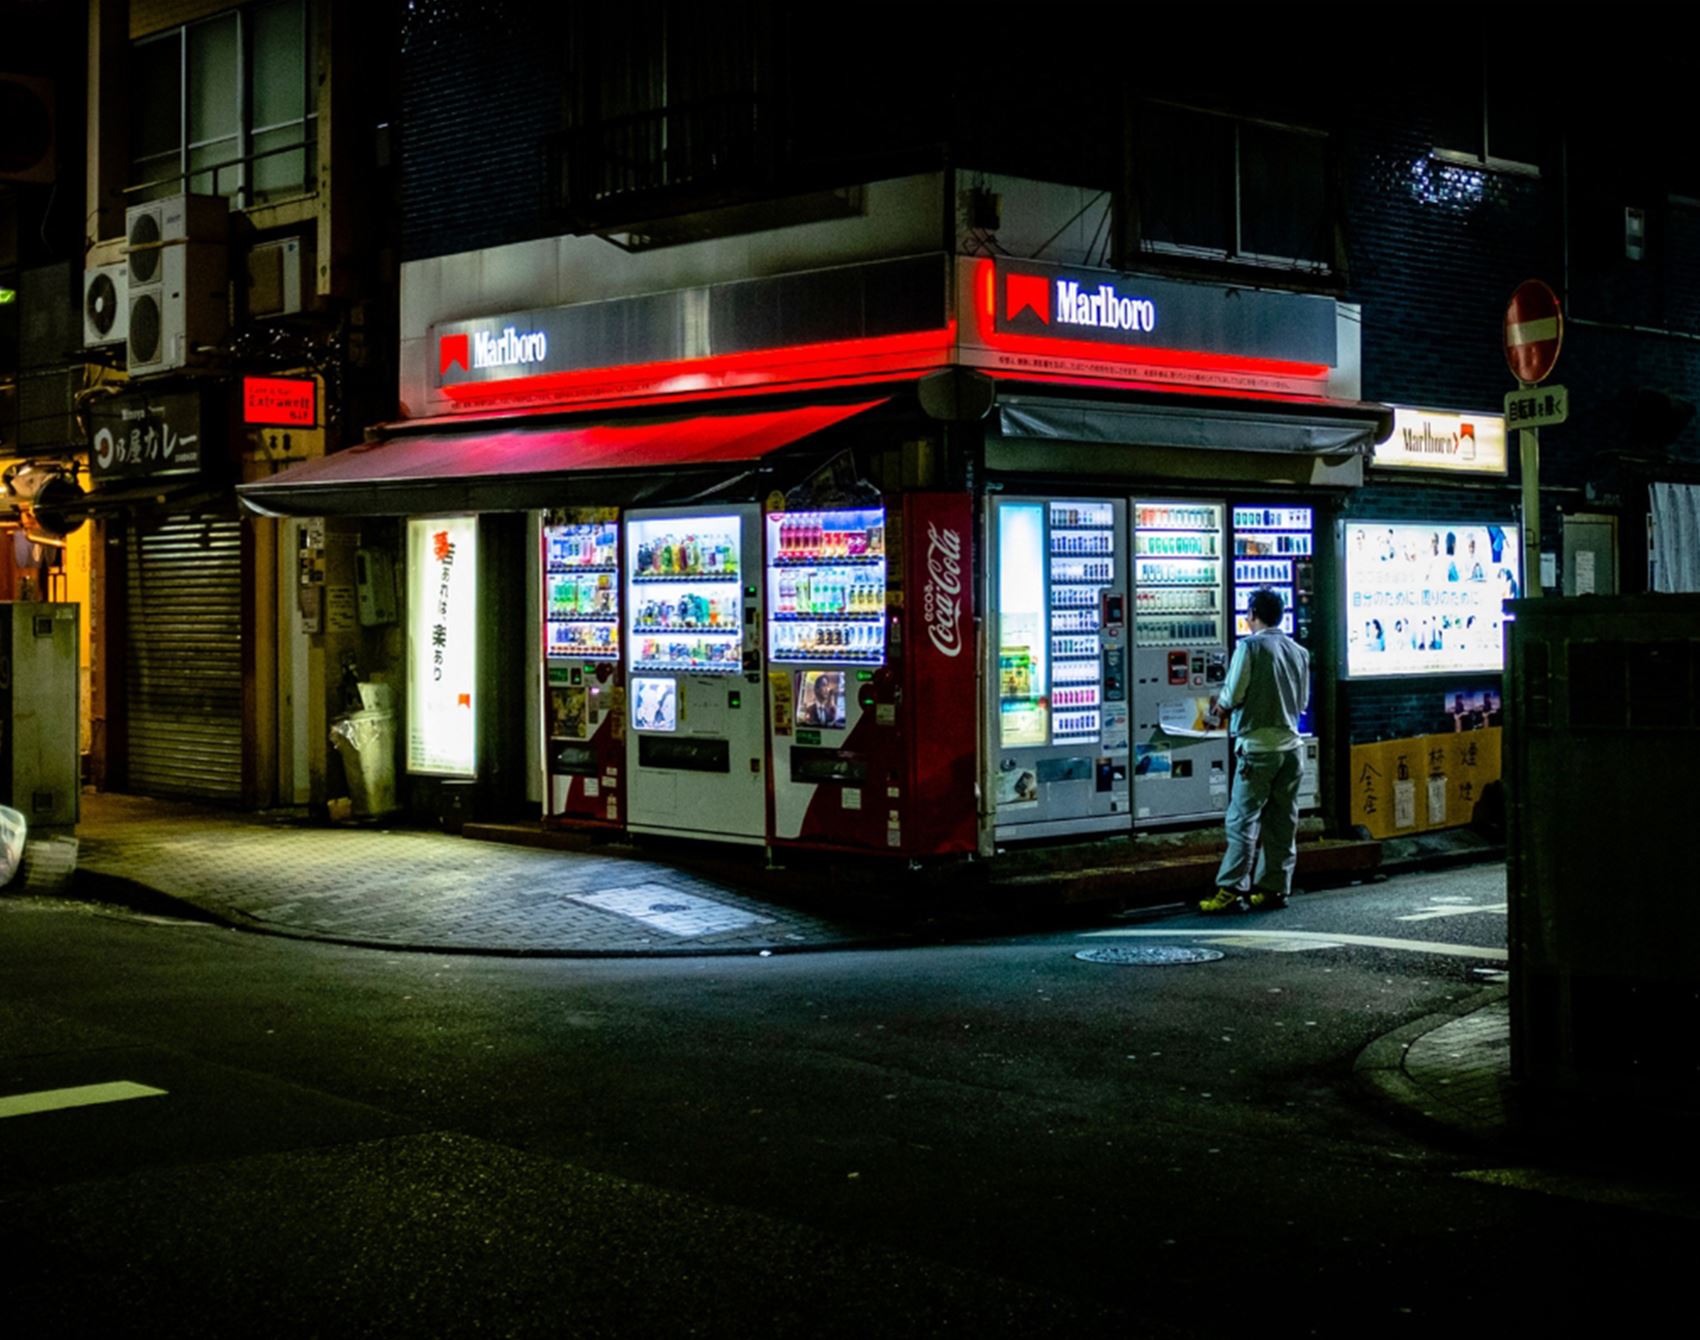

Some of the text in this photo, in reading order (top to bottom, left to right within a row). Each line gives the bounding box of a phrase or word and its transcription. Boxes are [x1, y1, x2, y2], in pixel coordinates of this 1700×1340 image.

[1056, 280, 1155, 332] Marlboro
[473, 327, 547, 368] Marlboro
[1509, 394, 1562, 421] 自転車を除く
[1402, 421, 1453, 454] Marlboro
